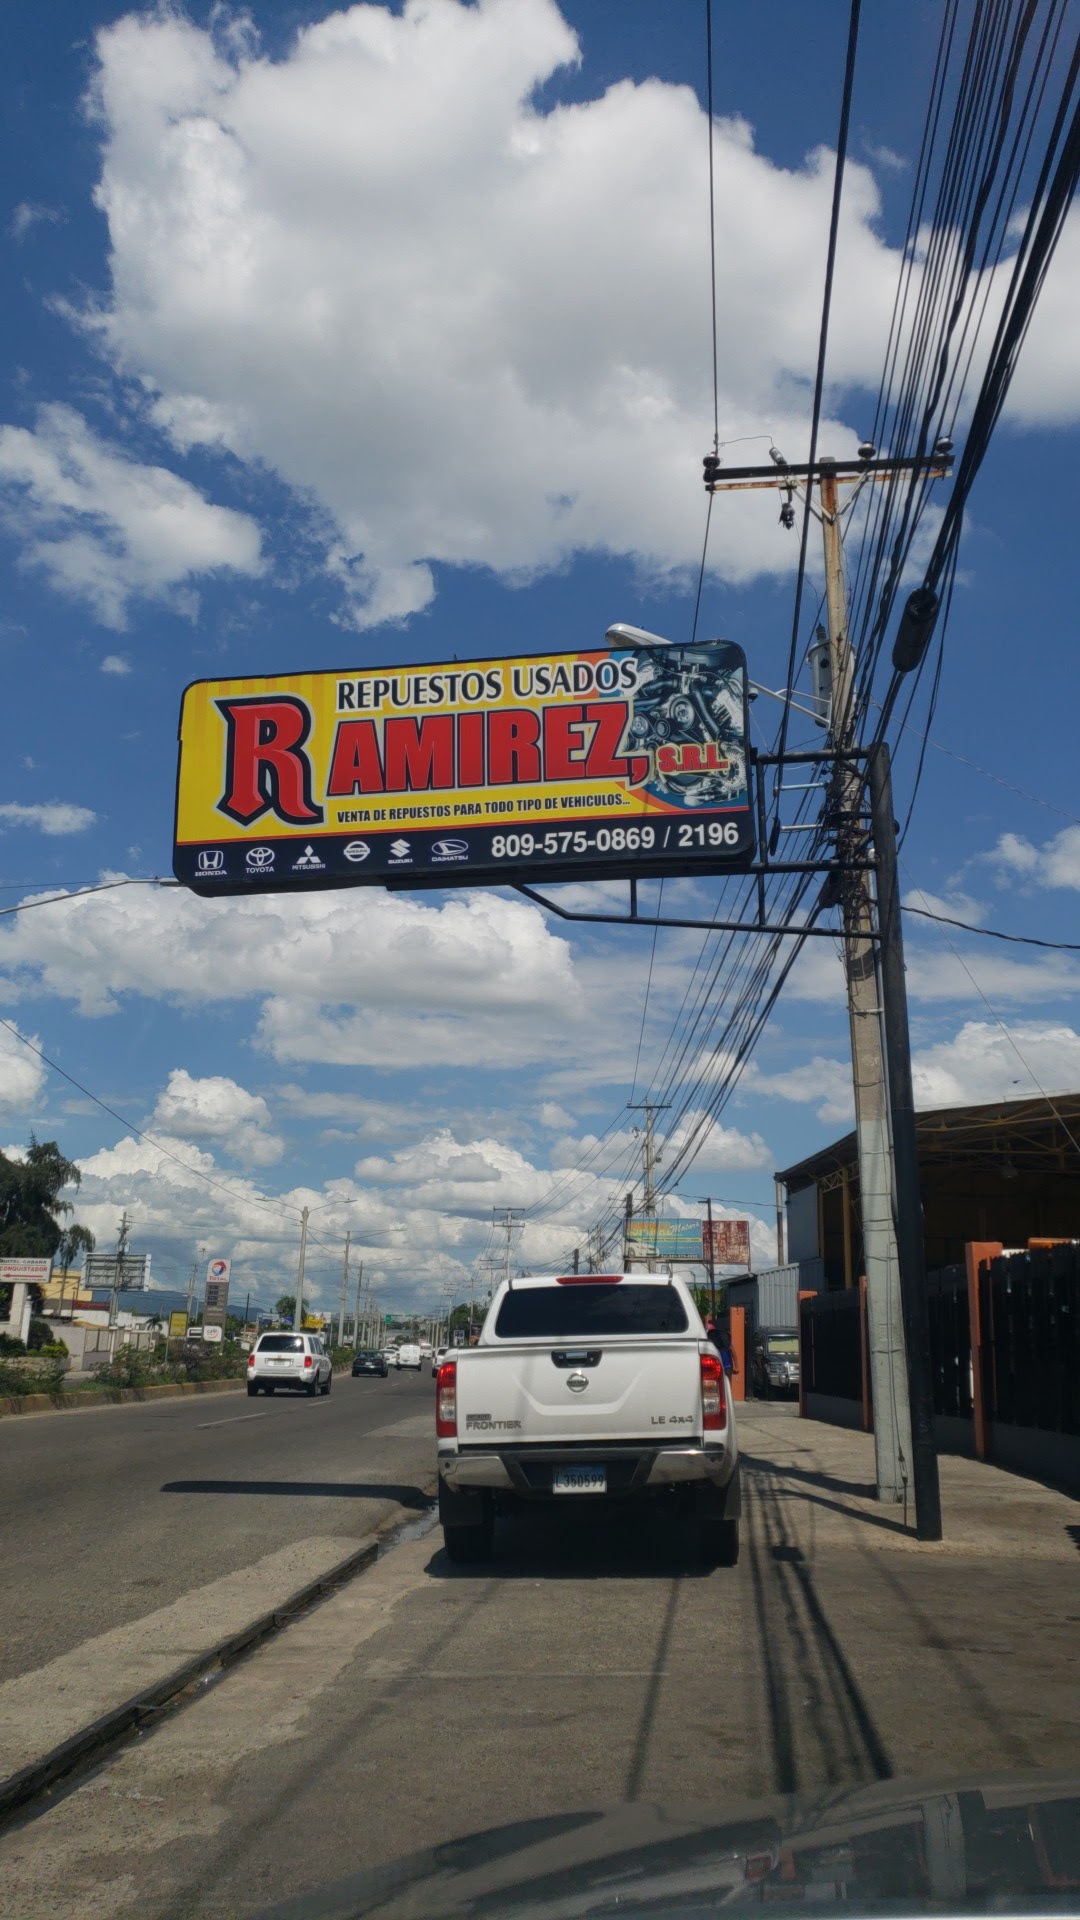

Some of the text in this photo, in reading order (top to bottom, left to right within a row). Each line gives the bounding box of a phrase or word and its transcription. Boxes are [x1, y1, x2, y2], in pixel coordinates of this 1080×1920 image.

[337, 659, 638, 710] REPUESTOS USADOS
[657, 743, 729, 774] S.R.L.
[337, 793, 631, 823] VENTA DE REPUESTOS PARA TODO TIPO DE VEHICULOS...
[491, 822, 739, 858] 809-575-0869 / 2196
[194, 869, 228, 877] HONDA
[245, 866, 275, 874] TOYOTA
[465, 1420, 522, 1430] FRONTIER
[650, 1415, 666, 1425] LE
[555, 1473, 605, 1488] L350599
